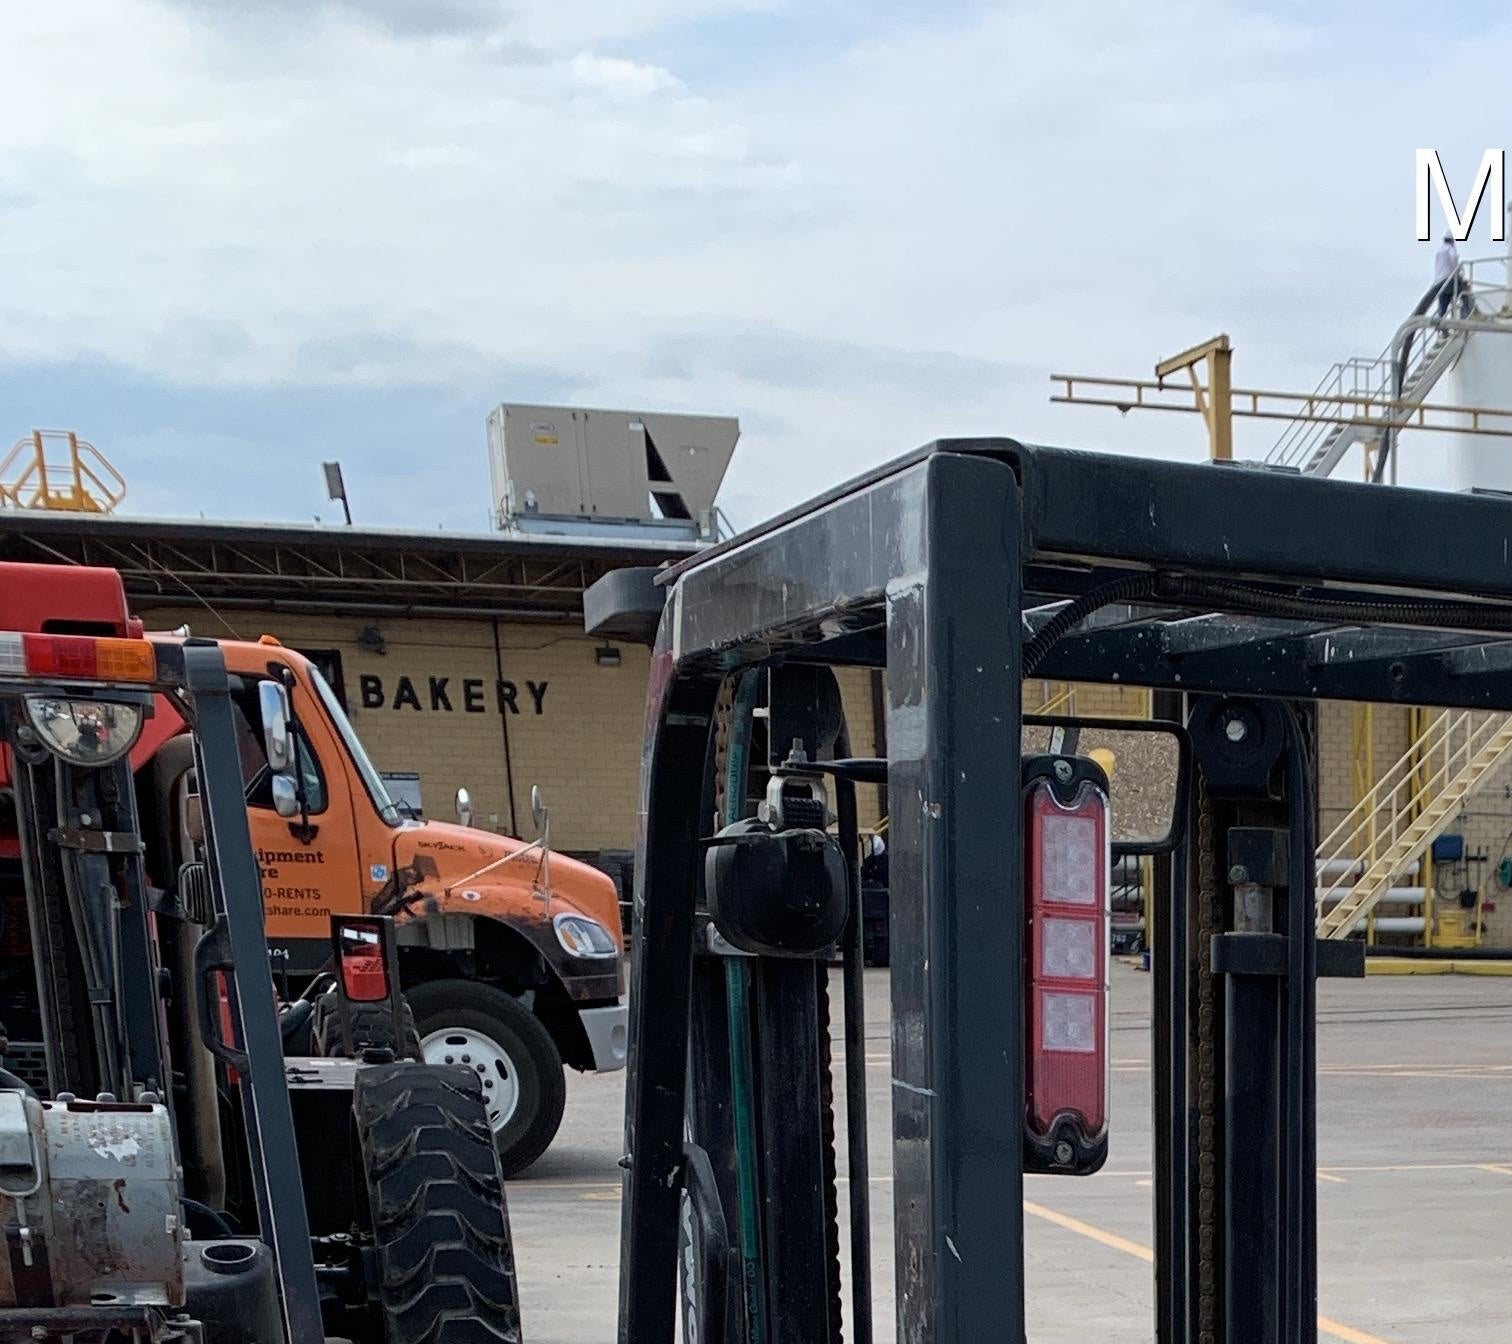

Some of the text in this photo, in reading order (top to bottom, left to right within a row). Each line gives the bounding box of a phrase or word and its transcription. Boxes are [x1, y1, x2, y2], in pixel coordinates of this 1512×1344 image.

[359, 673, 550, 716] BAKERY
[256, 847, 325, 865] ipment
[264, 887, 321, 899] 0-RENTS
